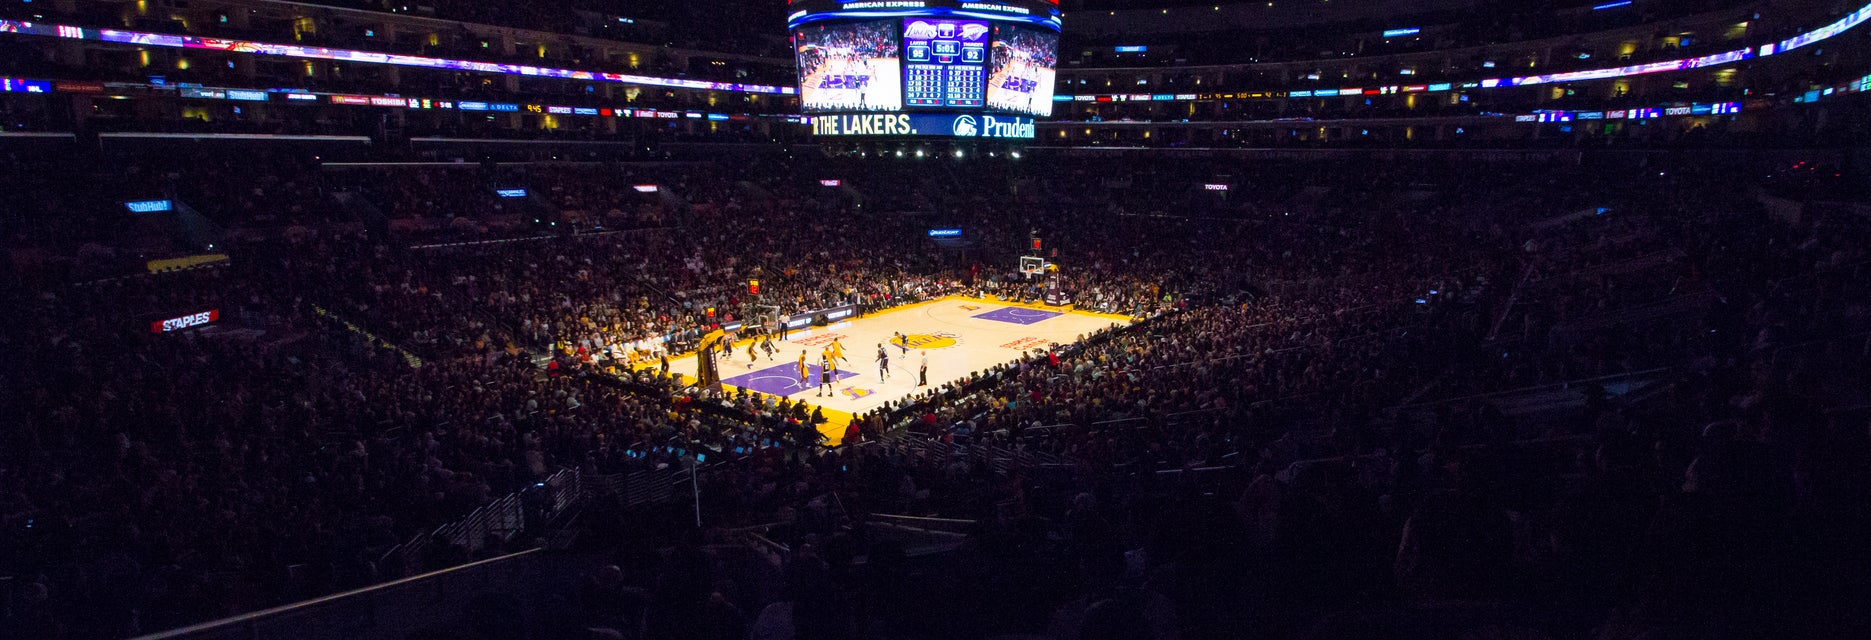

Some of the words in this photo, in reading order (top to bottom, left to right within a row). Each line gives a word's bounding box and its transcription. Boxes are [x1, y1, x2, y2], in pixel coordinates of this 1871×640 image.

[962, 3, 1001, 11] AMERICAN
[1003, 6, 1030, 14] EXPRESS
[936, 44, 955, 53] 5:01
[912, 49, 924, 58] 95
[966, 51, 979, 60] 92
[372, 98, 406, 106] TOSHIBA
[656, 111, 678, 119] TOYOTA
[1665, 107, 1691, 115] TOYOTA
[819, 115, 839, 135] THE
[843, 114, 918, 135] LAKERS.
[129, 200, 168, 212] StubHub!
[163, 311, 211, 331] STAPLES
